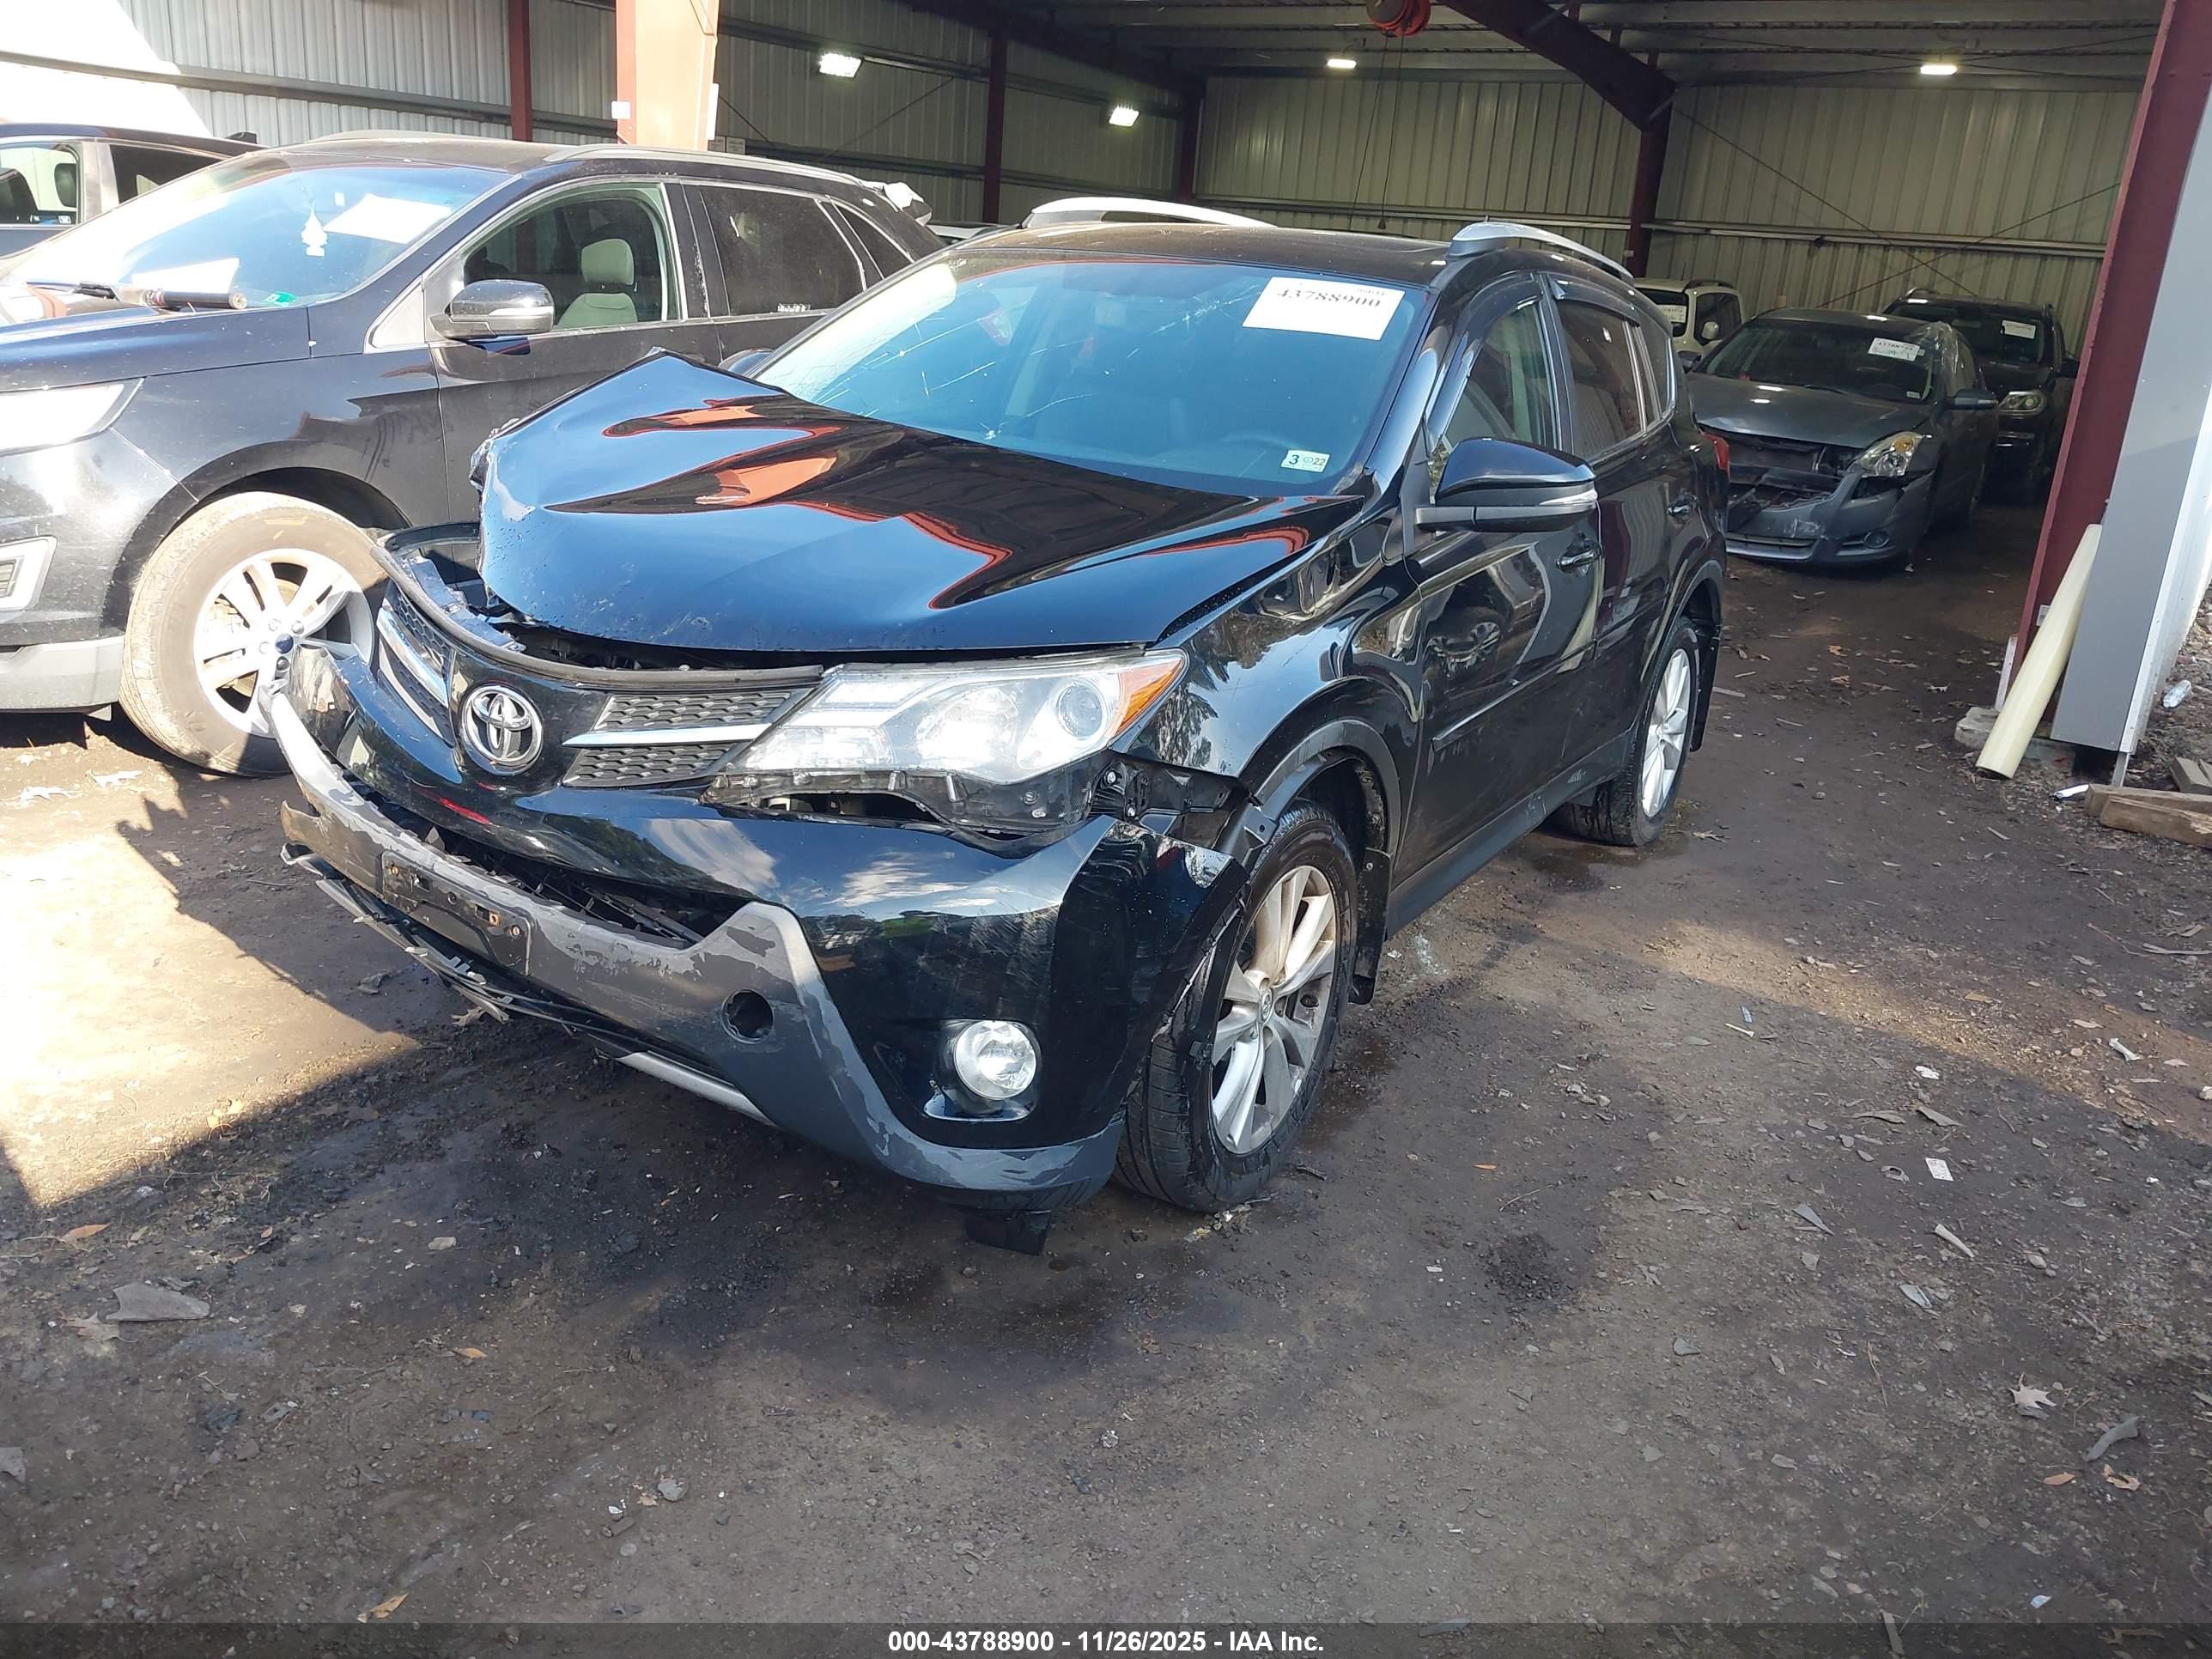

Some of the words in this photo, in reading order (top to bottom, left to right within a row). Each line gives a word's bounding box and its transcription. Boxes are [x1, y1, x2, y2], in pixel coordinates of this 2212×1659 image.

[1276, 288, 1381, 307] 43788900
[1288, 454, 1300, 465] 3
[1312, 457, 1327, 466] 22
